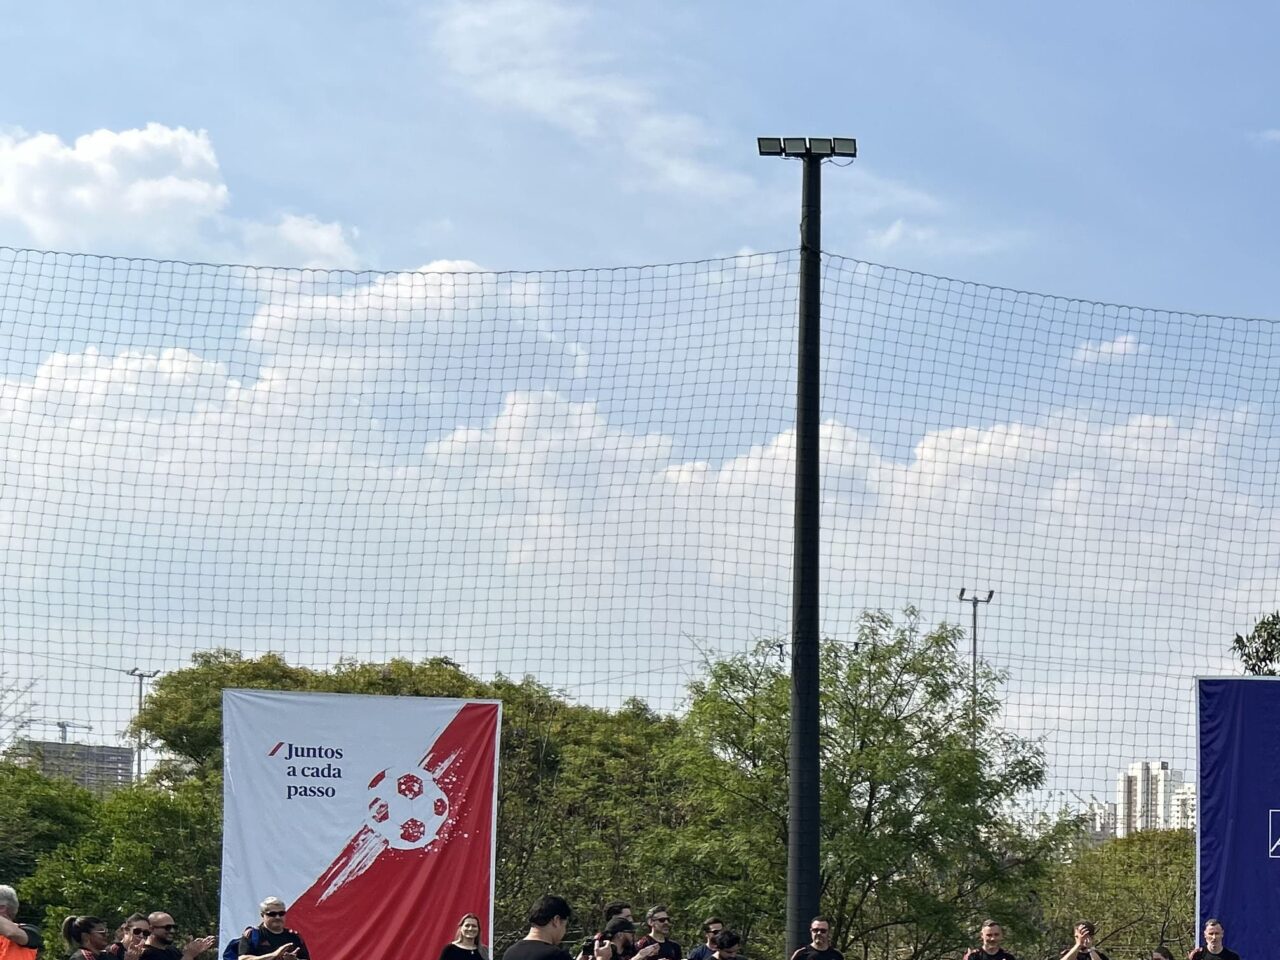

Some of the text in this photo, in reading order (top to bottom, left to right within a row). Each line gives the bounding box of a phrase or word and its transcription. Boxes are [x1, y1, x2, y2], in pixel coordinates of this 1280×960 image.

[284, 743, 344, 760] Juntos
[287, 763, 342, 778] a cada
[286, 783, 336, 799] passo
